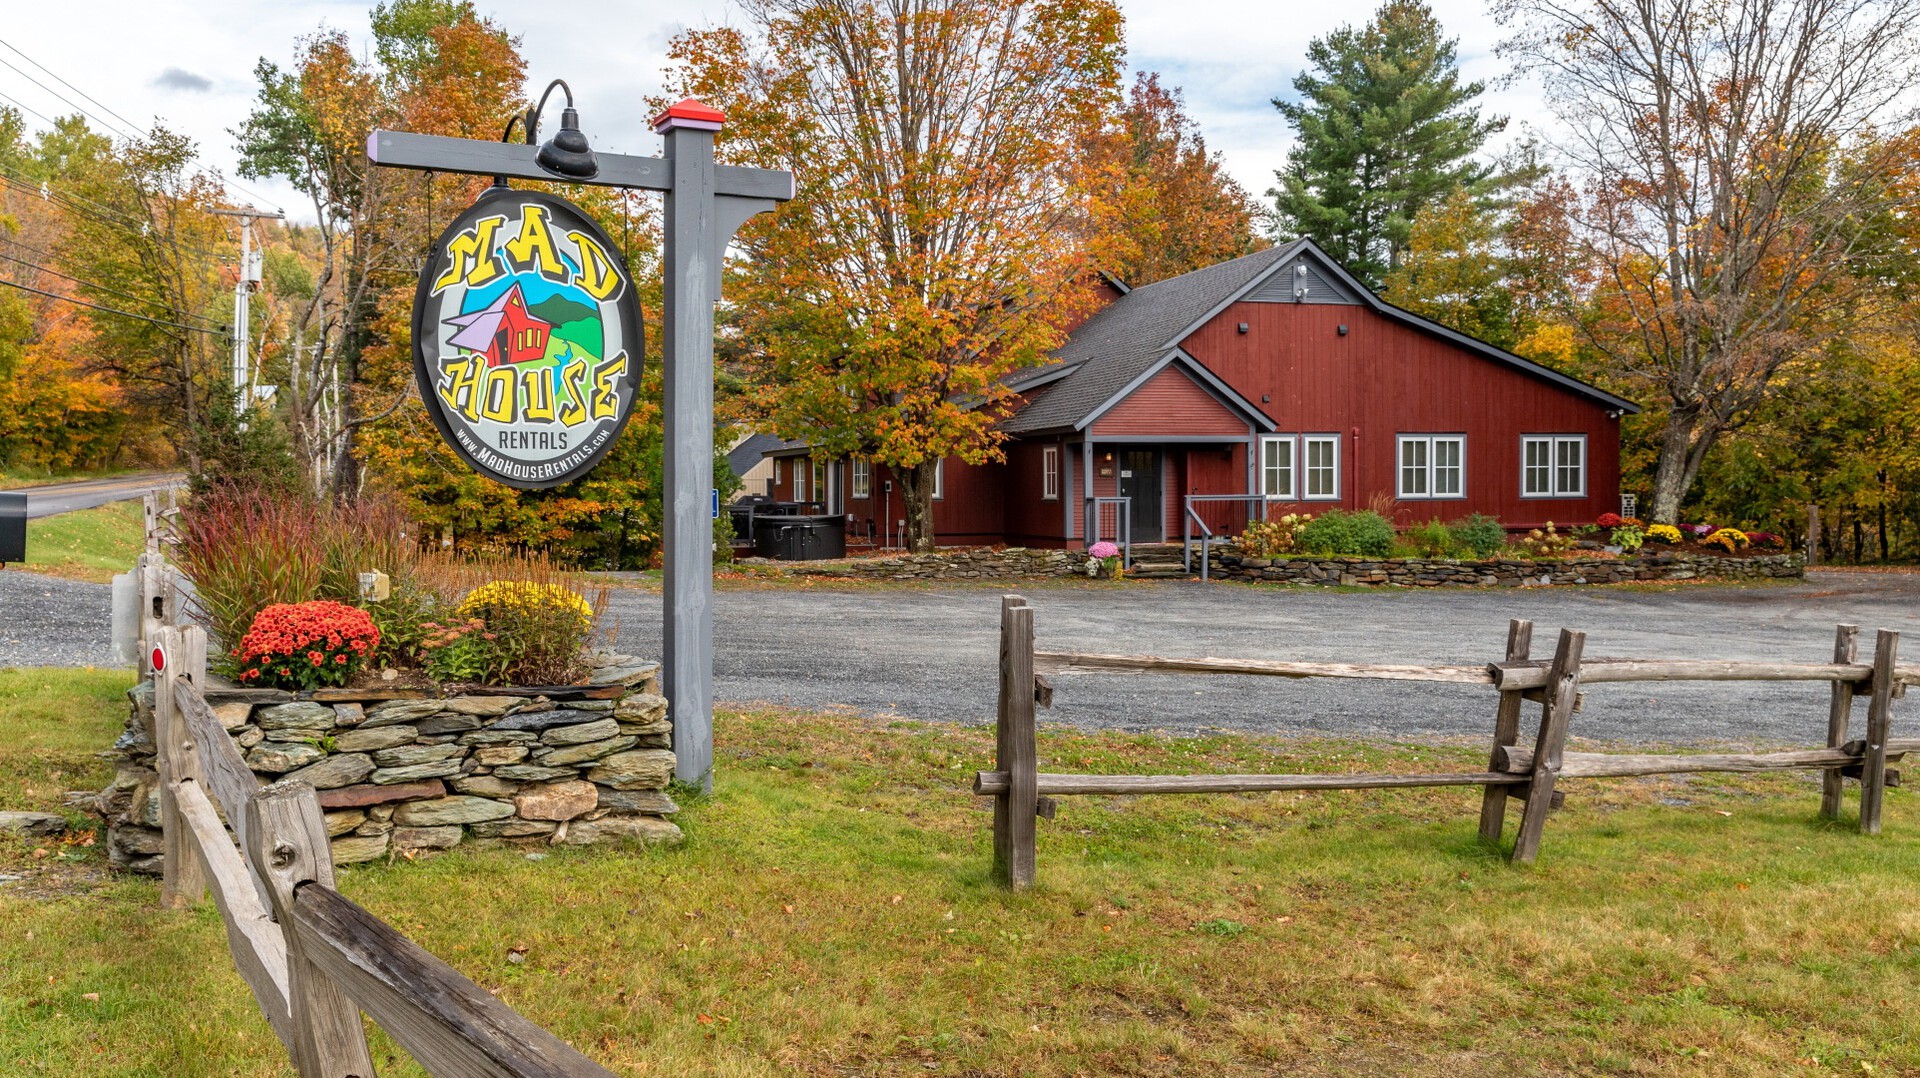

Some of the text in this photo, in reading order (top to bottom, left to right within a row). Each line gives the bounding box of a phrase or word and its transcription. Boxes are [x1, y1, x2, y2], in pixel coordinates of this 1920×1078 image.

[430, 204, 627, 302] MAD
[438, 350, 628, 429] HOUSE
[499, 431, 568, 450] RENTALS
